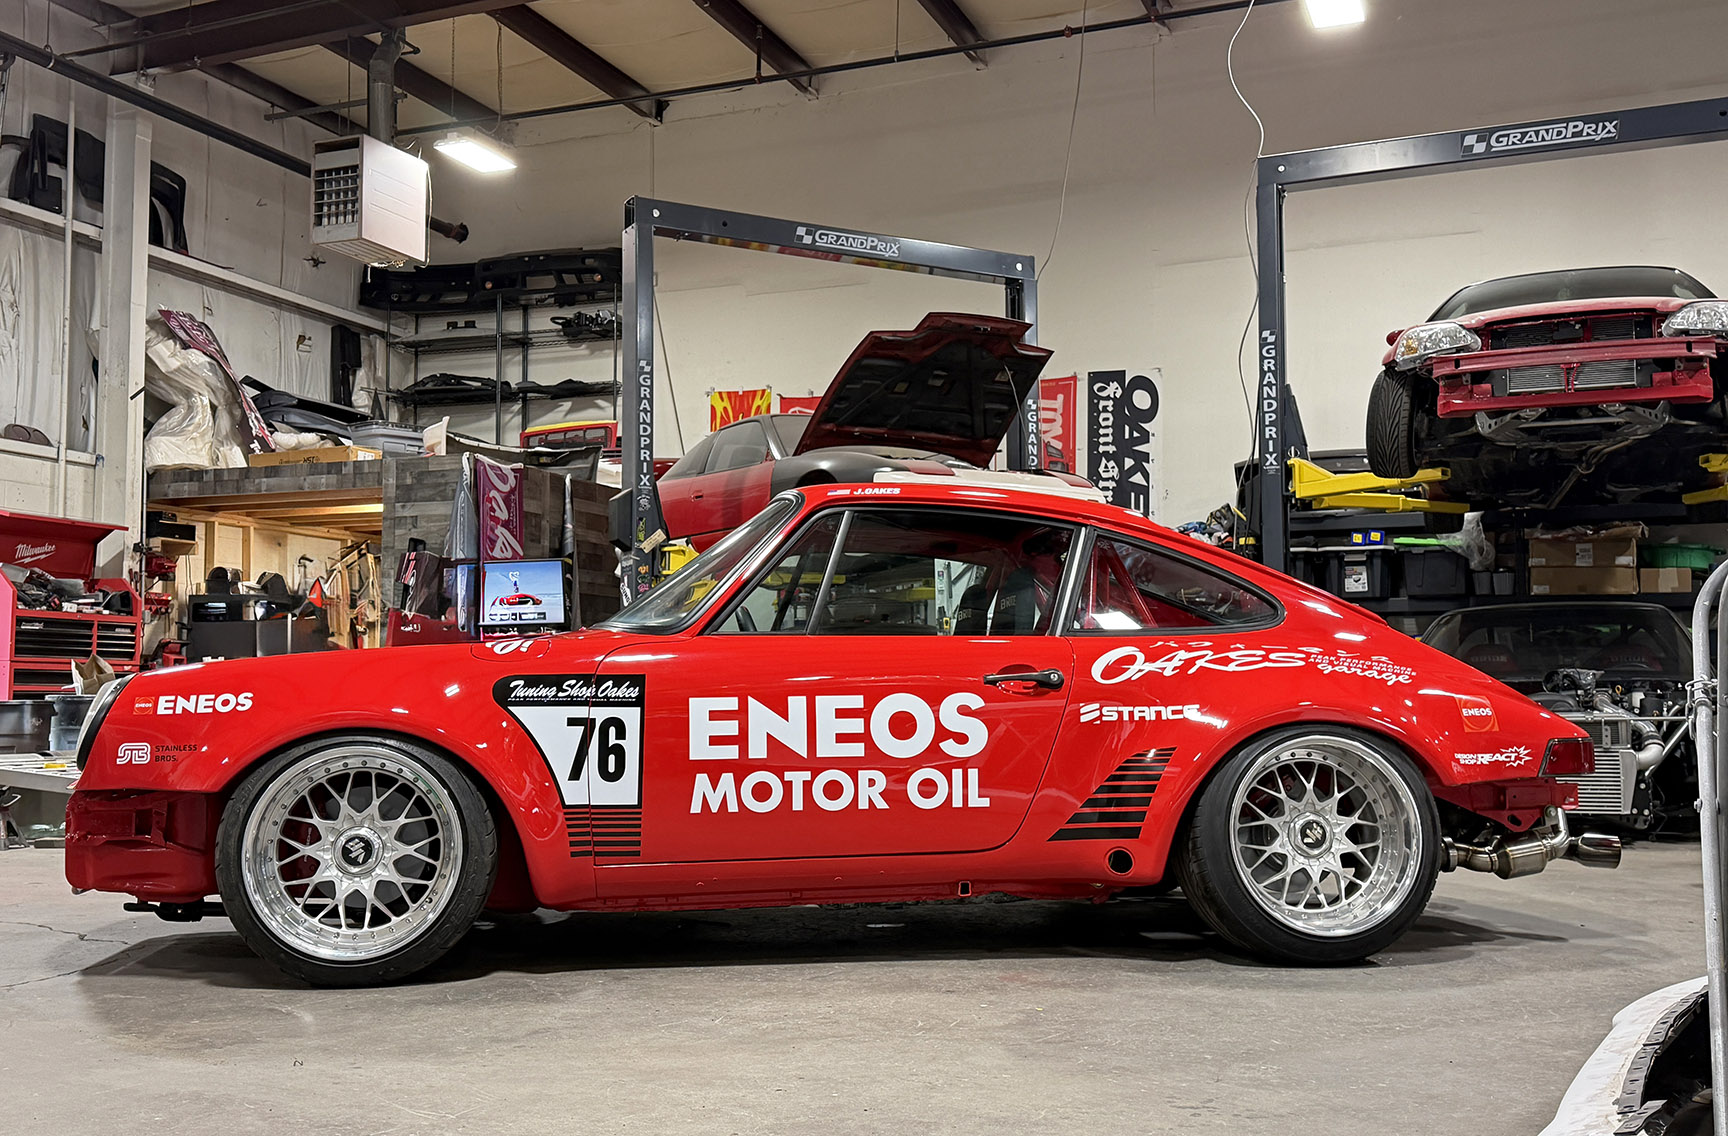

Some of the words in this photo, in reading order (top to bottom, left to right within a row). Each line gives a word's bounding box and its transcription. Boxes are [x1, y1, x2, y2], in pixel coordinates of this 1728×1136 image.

[1490, 120, 1618, 147] GRANDPRIX
[815, 230, 900, 257] GRANDPRIX
[1093, 381, 1123, 454] Front
[1262, 345, 1278, 466] GRANDPRIX
[639, 374, 651, 486] GRANDPRIX
[1027, 411, 1038, 468] GRAND
[15, 543, 56, 559] Milwaukee
[1091, 646, 1306, 684] OAKES
[1317, 663, 1412, 686] garage
[509, 680, 557, 698] Tuning
[557, 680, 595, 698] Shop
[597, 680, 640, 698] Oakes
[157, 692, 254, 715] ENEOS
[1462, 708, 1493, 717] ENEOS
[688, 692, 989, 760] ENEOS
[154, 744, 198, 753] STAINLESS
[154, 755, 178, 763] BROS.
[566, 716, 627, 783] 76
[1476, 753, 1519, 765] REACT
[690, 769, 890, 814] MOTOR
[906, 767, 990, 810] OIL
